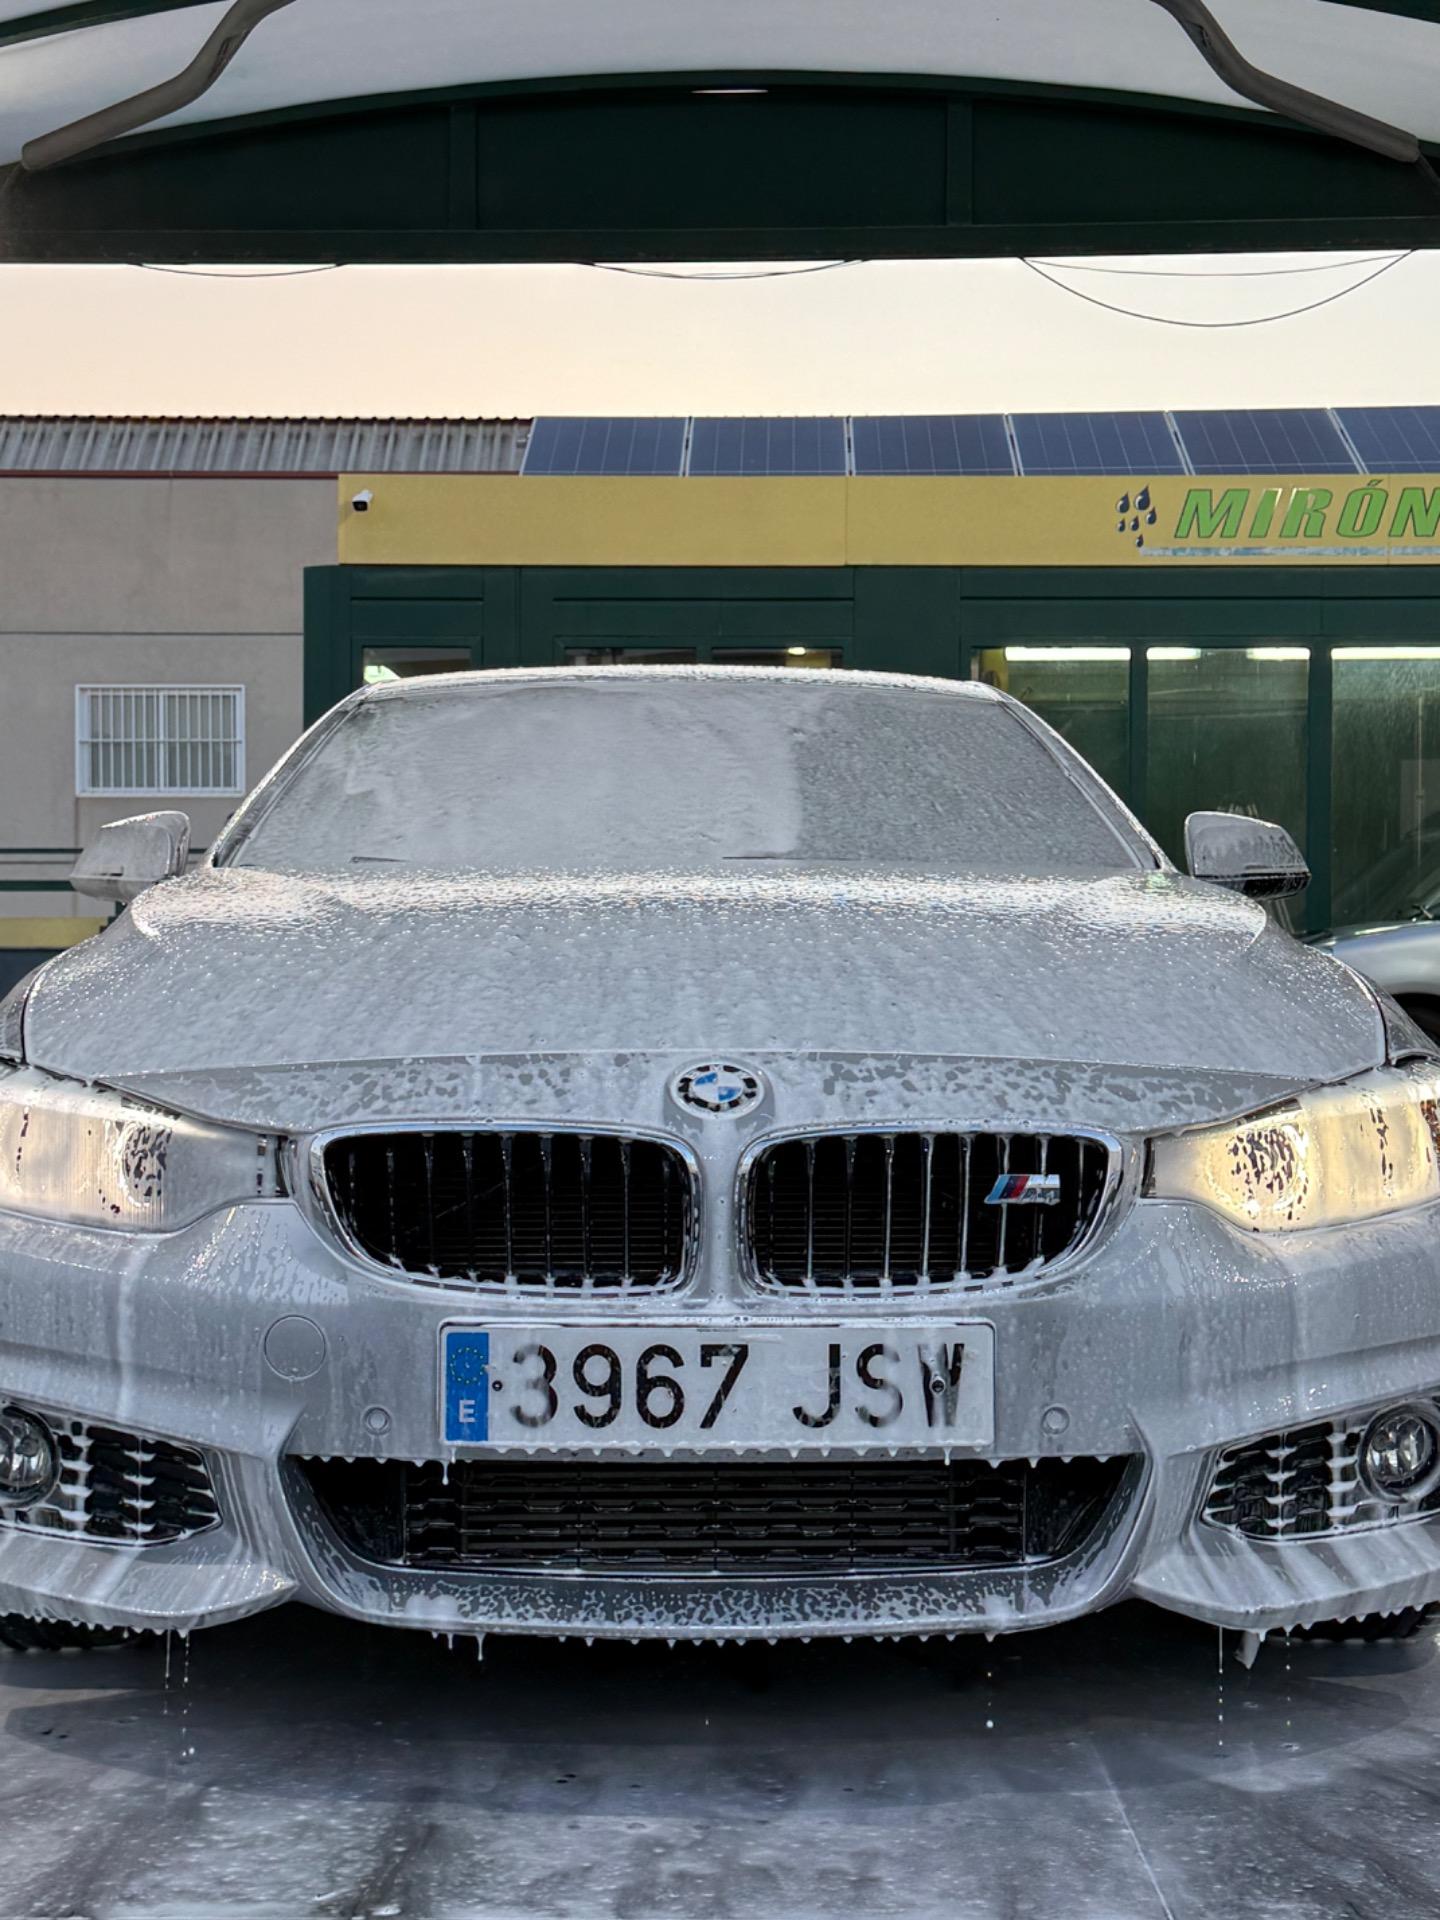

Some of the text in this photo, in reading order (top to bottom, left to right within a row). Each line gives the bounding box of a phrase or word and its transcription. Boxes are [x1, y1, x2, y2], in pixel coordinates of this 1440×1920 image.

[1174, 479, 1440, 538] MIRÓN
[458, 1399, 476, 1423] E
[510, 1343, 965, 1428] 3967 JSW
